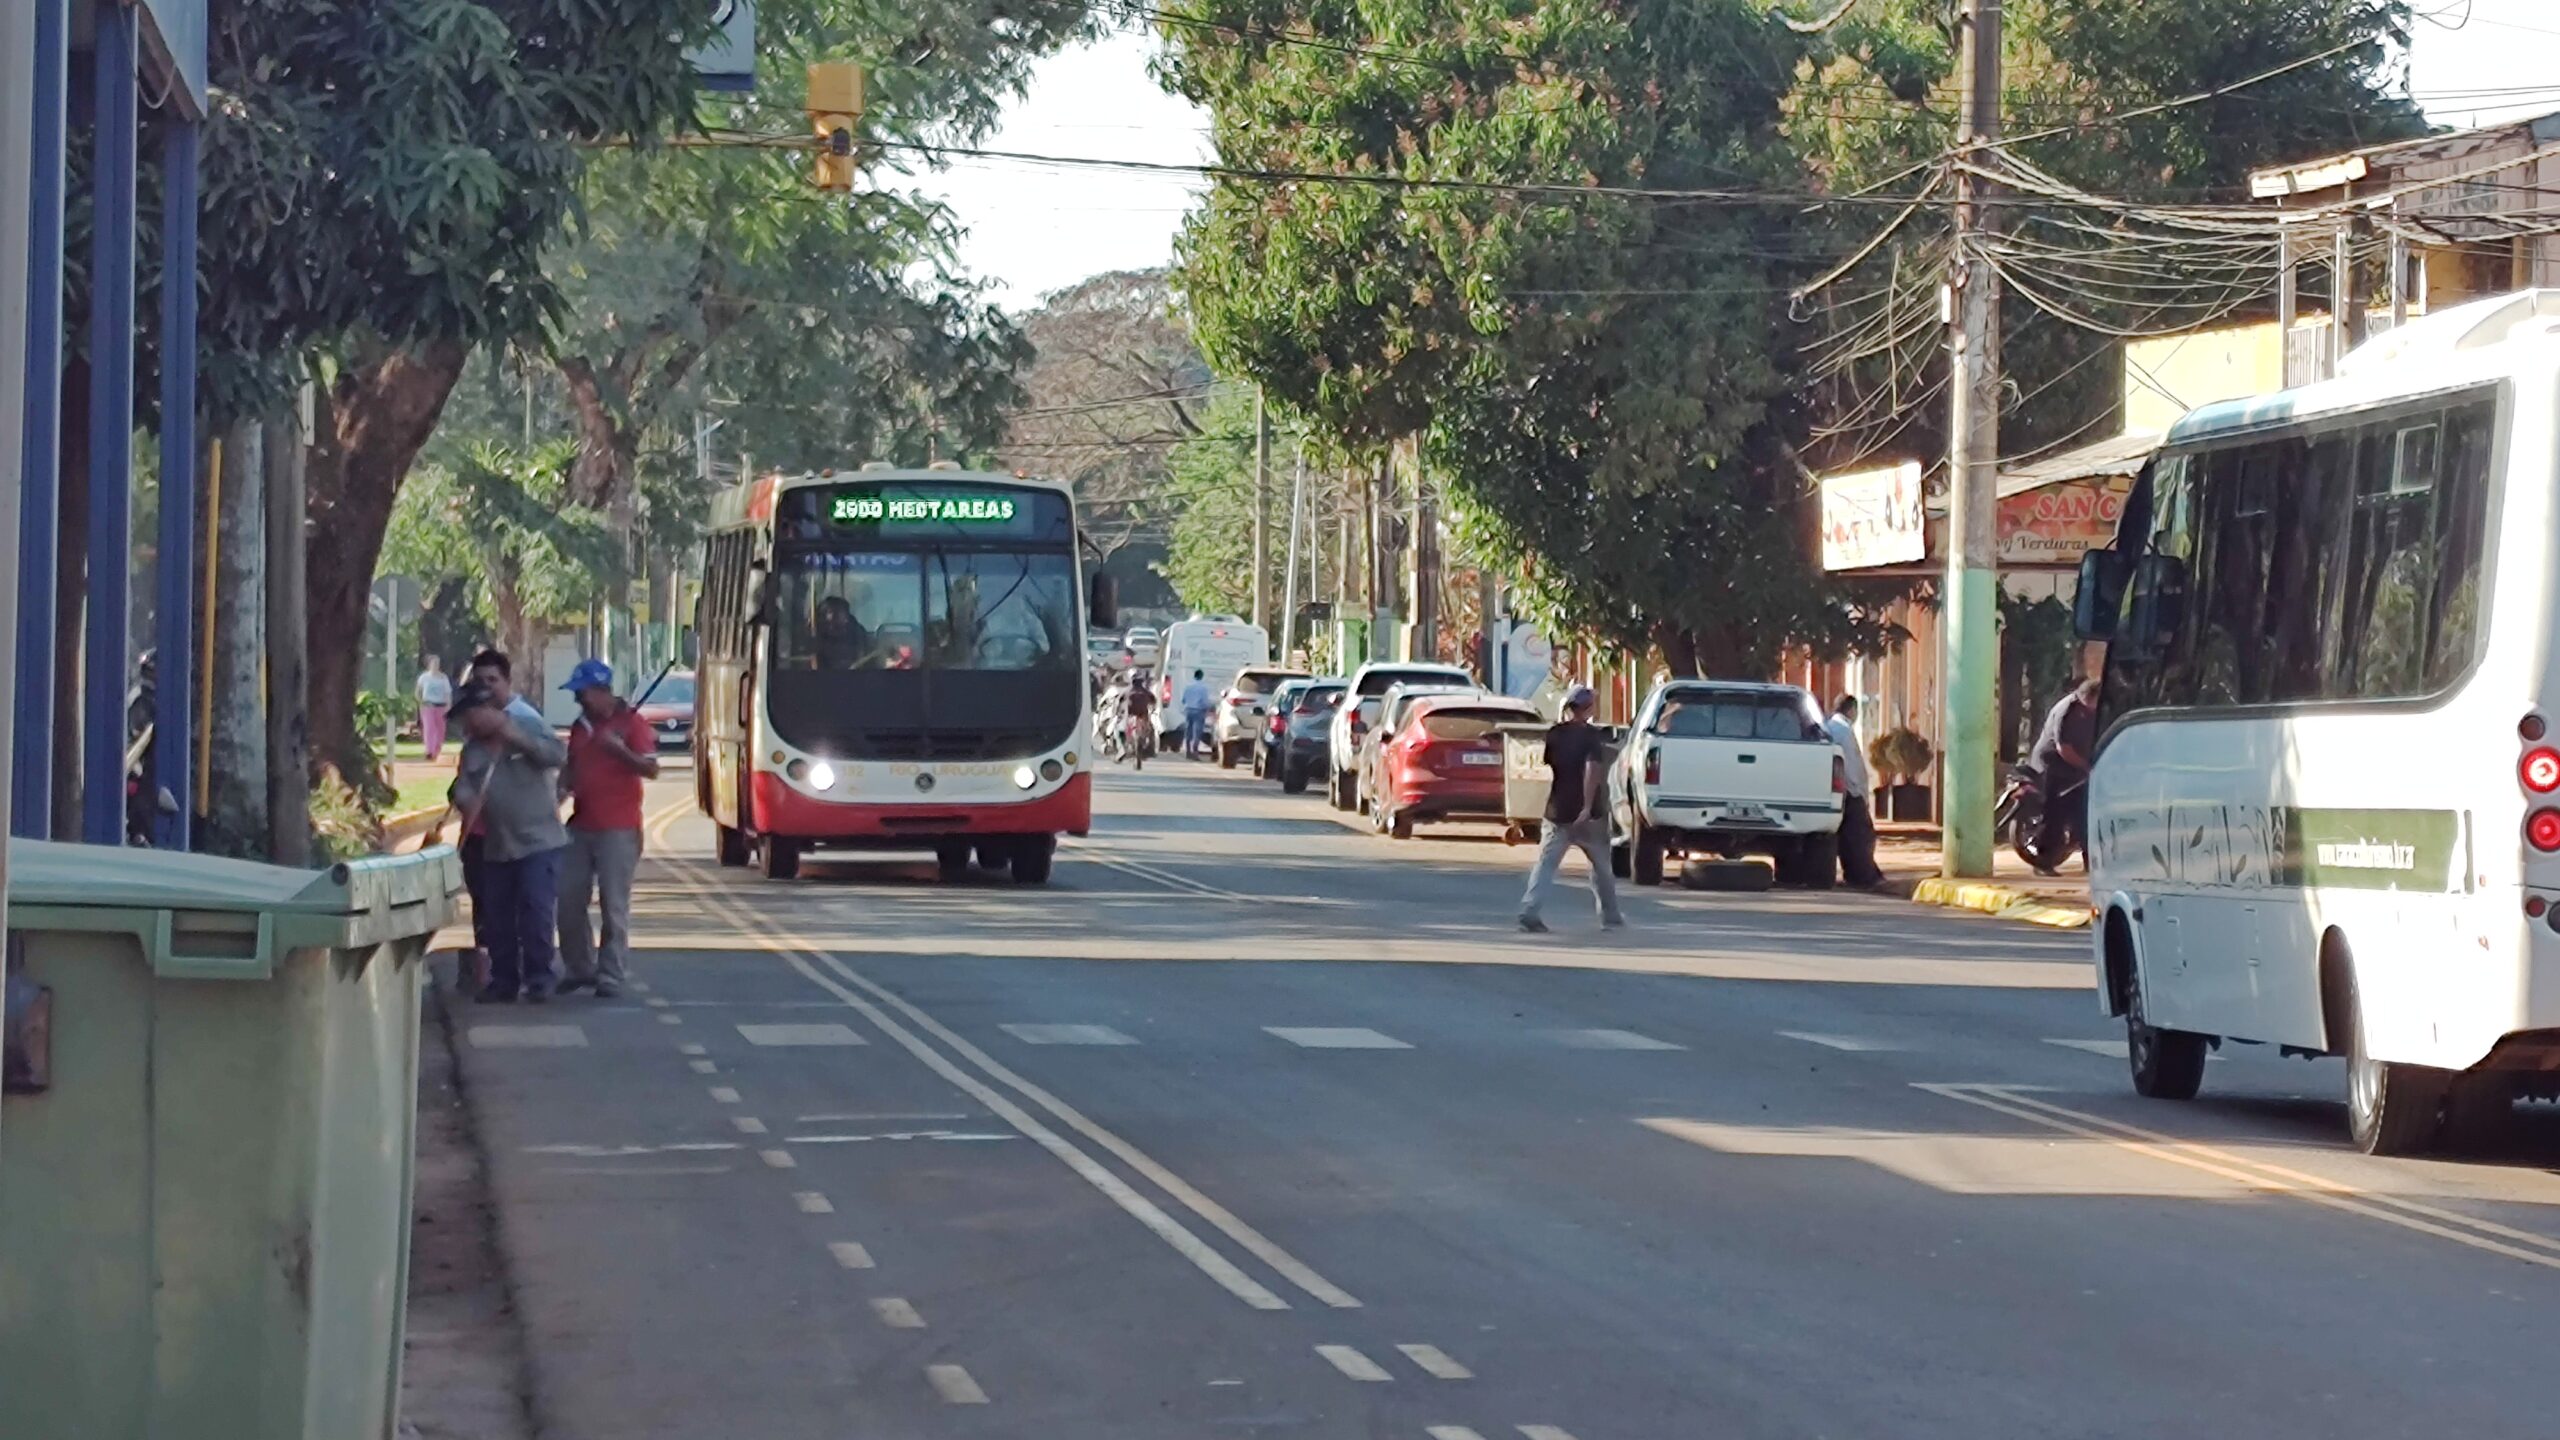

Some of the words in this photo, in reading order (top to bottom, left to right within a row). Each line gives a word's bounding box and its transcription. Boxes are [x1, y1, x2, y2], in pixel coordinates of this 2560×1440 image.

[888, 499, 1014, 520] HECTAREAS
[2036, 494, 2095, 520] SAN
[2016, 535, 2089, 551] Verduras
